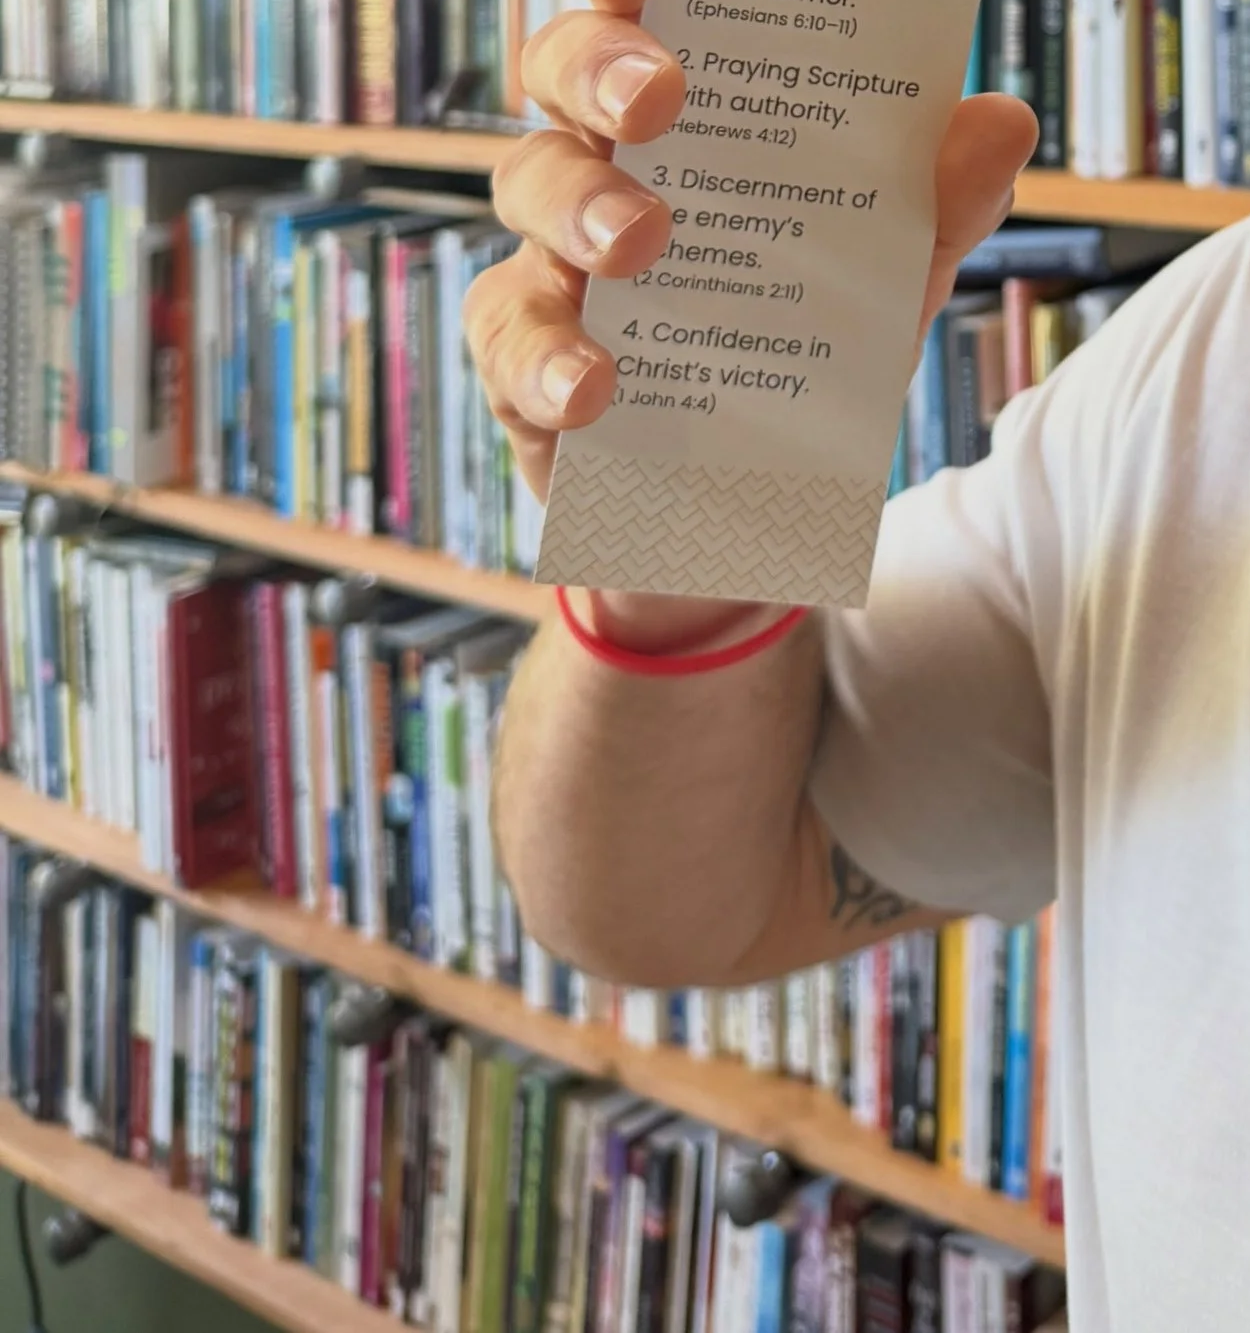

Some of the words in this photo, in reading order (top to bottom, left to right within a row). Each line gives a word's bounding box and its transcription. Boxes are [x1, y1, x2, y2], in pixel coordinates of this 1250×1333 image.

[676, 49, 695, 70] 2.
[703, 52, 800, 88] Praying
[808, 66, 920, 104] Scripture
[685, 85, 722, 109] ith
[730, 95, 850, 129] authority.
[665, 118, 752, 140] Hebrews
[757, 127, 797, 149] 4:12)
[652, 165, 672, 187] 3.
[680, 169, 845, 206] Discernment
[851, 189, 878, 211] of
[695, 210, 804, 242] enemy's
[660, 239, 762, 268] hemes.
[657, 272, 765, 297] Corinthians
[769, 283, 804, 304] 2:11)
[622, 319, 643, 341] 4.
[652, 321, 802, 355] Confidence
[809, 337, 830, 359] in
[616, 355, 711, 383] Christ's
[720, 365, 810, 398] victory.
[630, 390, 675, 408] John
[681, 394, 716, 415] 4:4)
